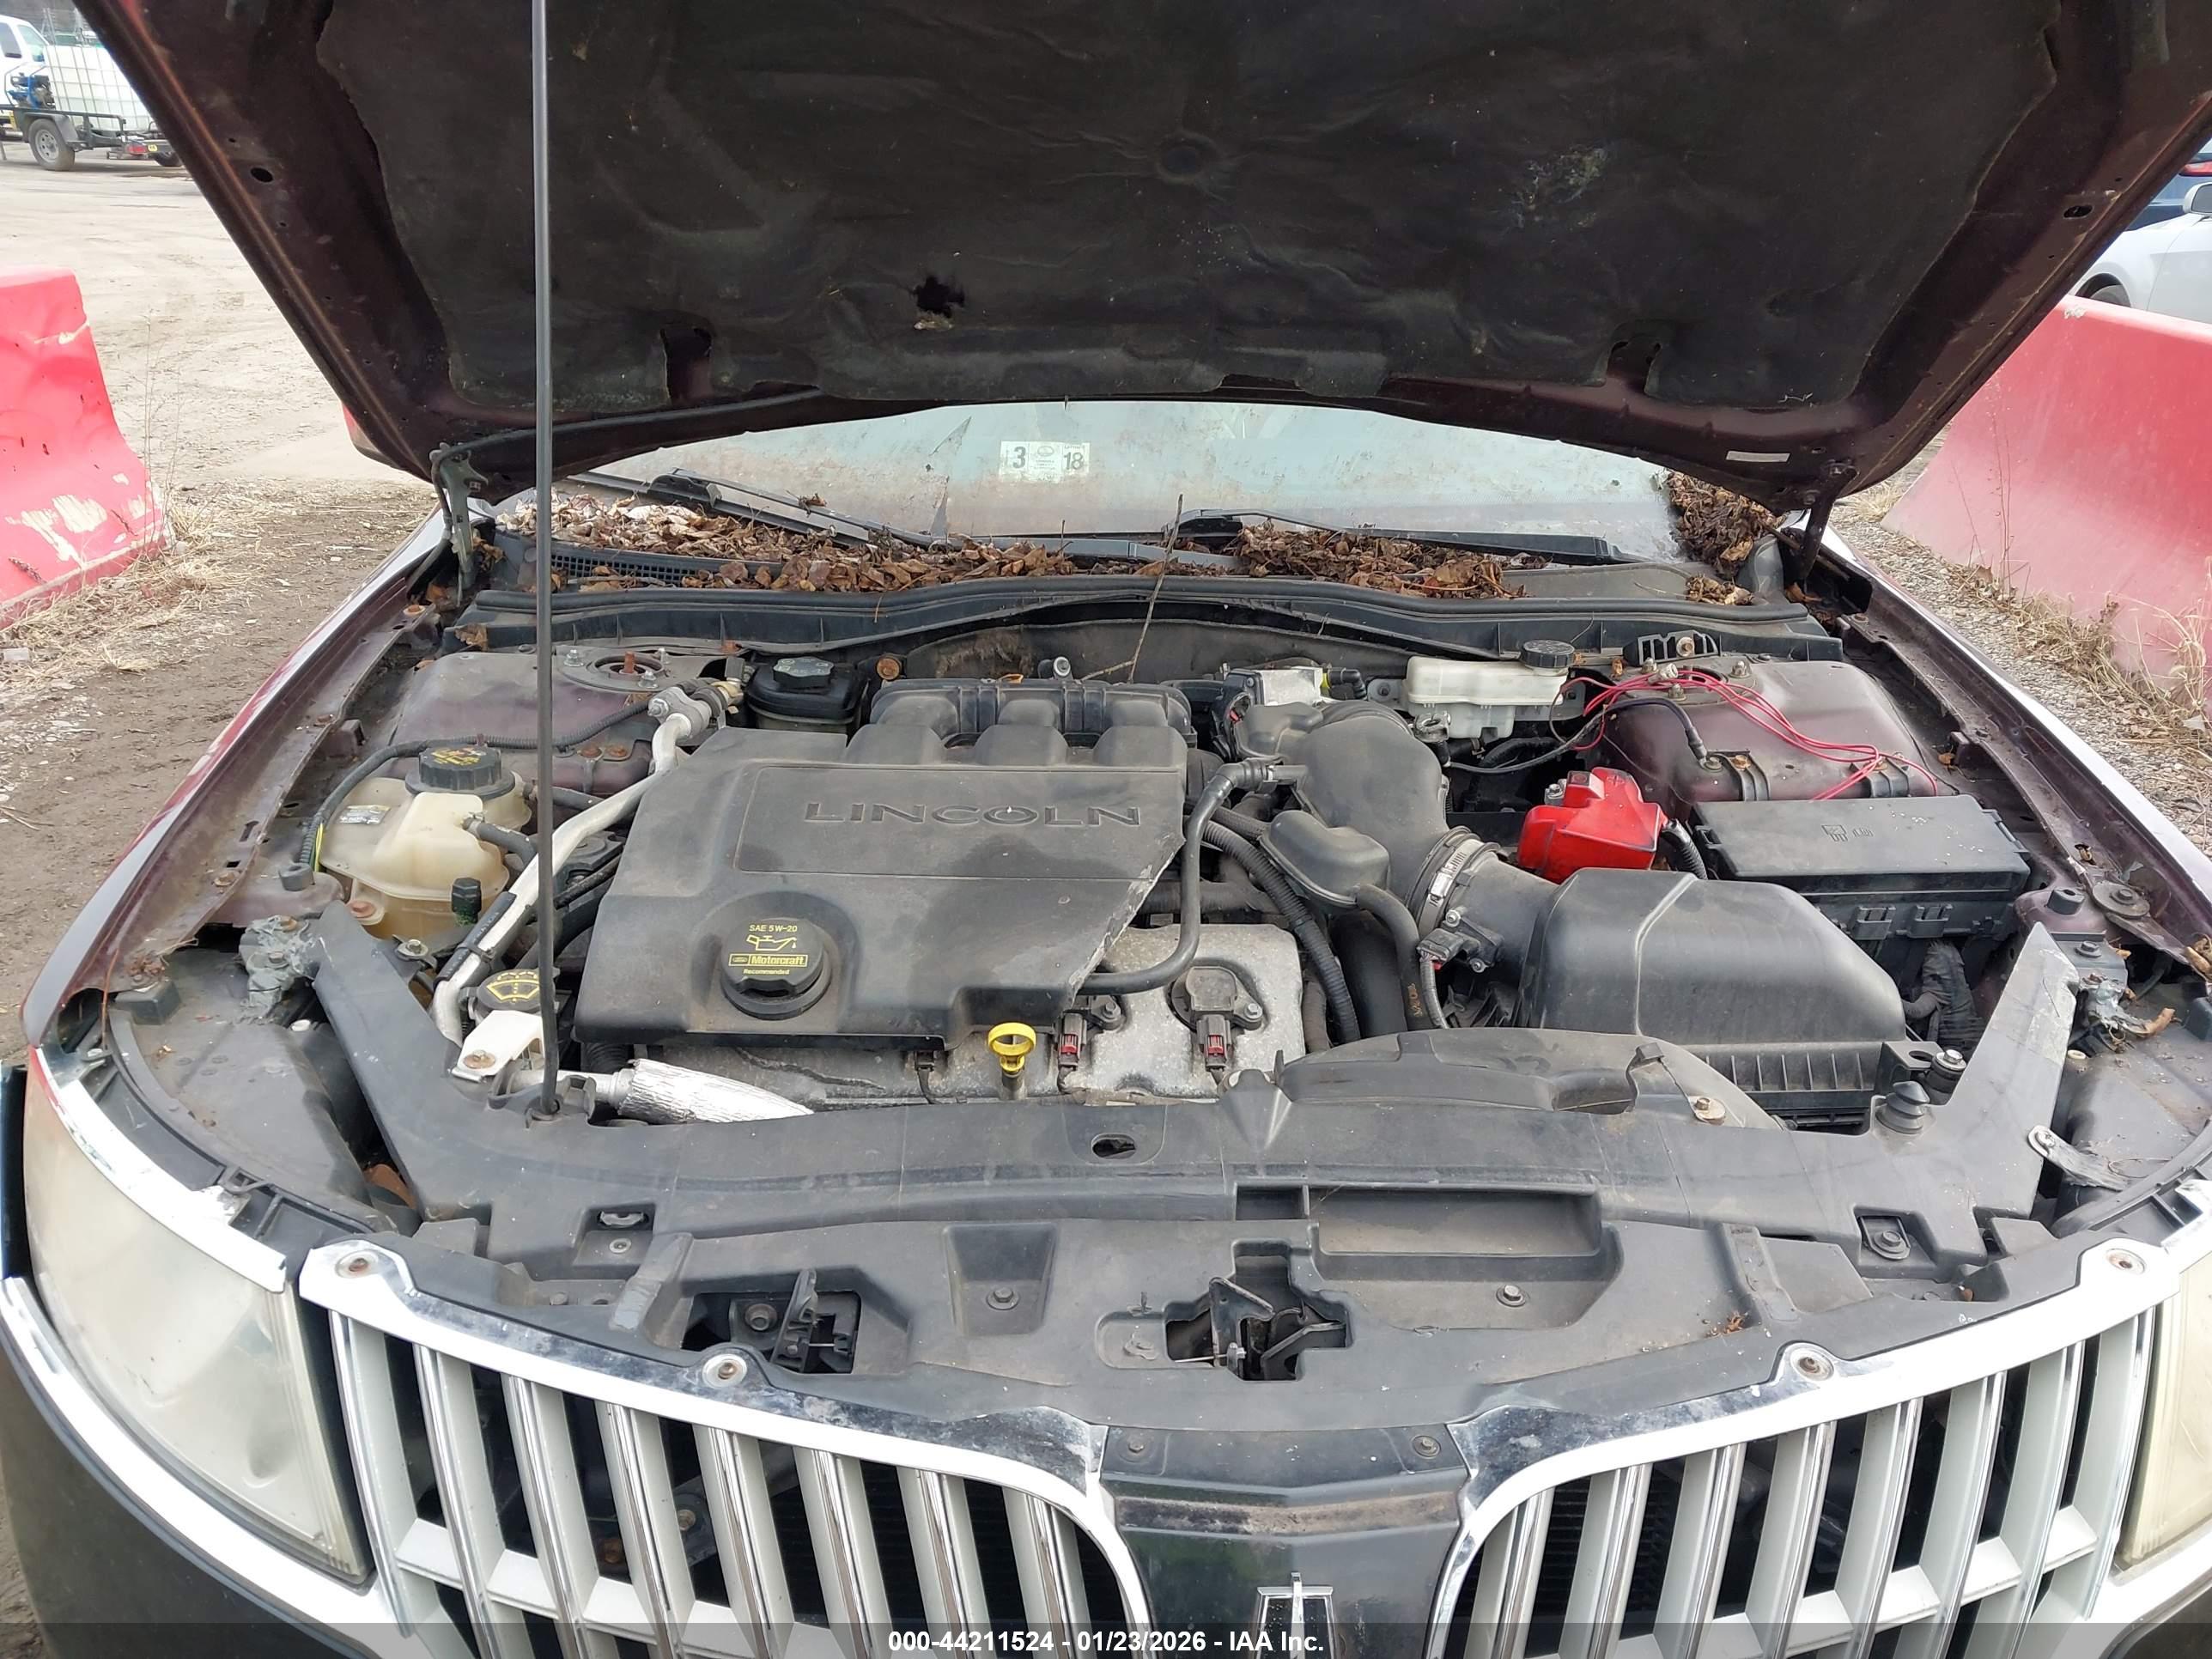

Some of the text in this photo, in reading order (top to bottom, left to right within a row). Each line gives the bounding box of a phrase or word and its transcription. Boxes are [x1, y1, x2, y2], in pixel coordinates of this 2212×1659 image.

[1012, 446, 1026, 469] 3
[1063, 452, 1084, 470] 18
[804, 802, 1140, 826] LINCOLN
[750, 955, 805, 965] Motorcraft
